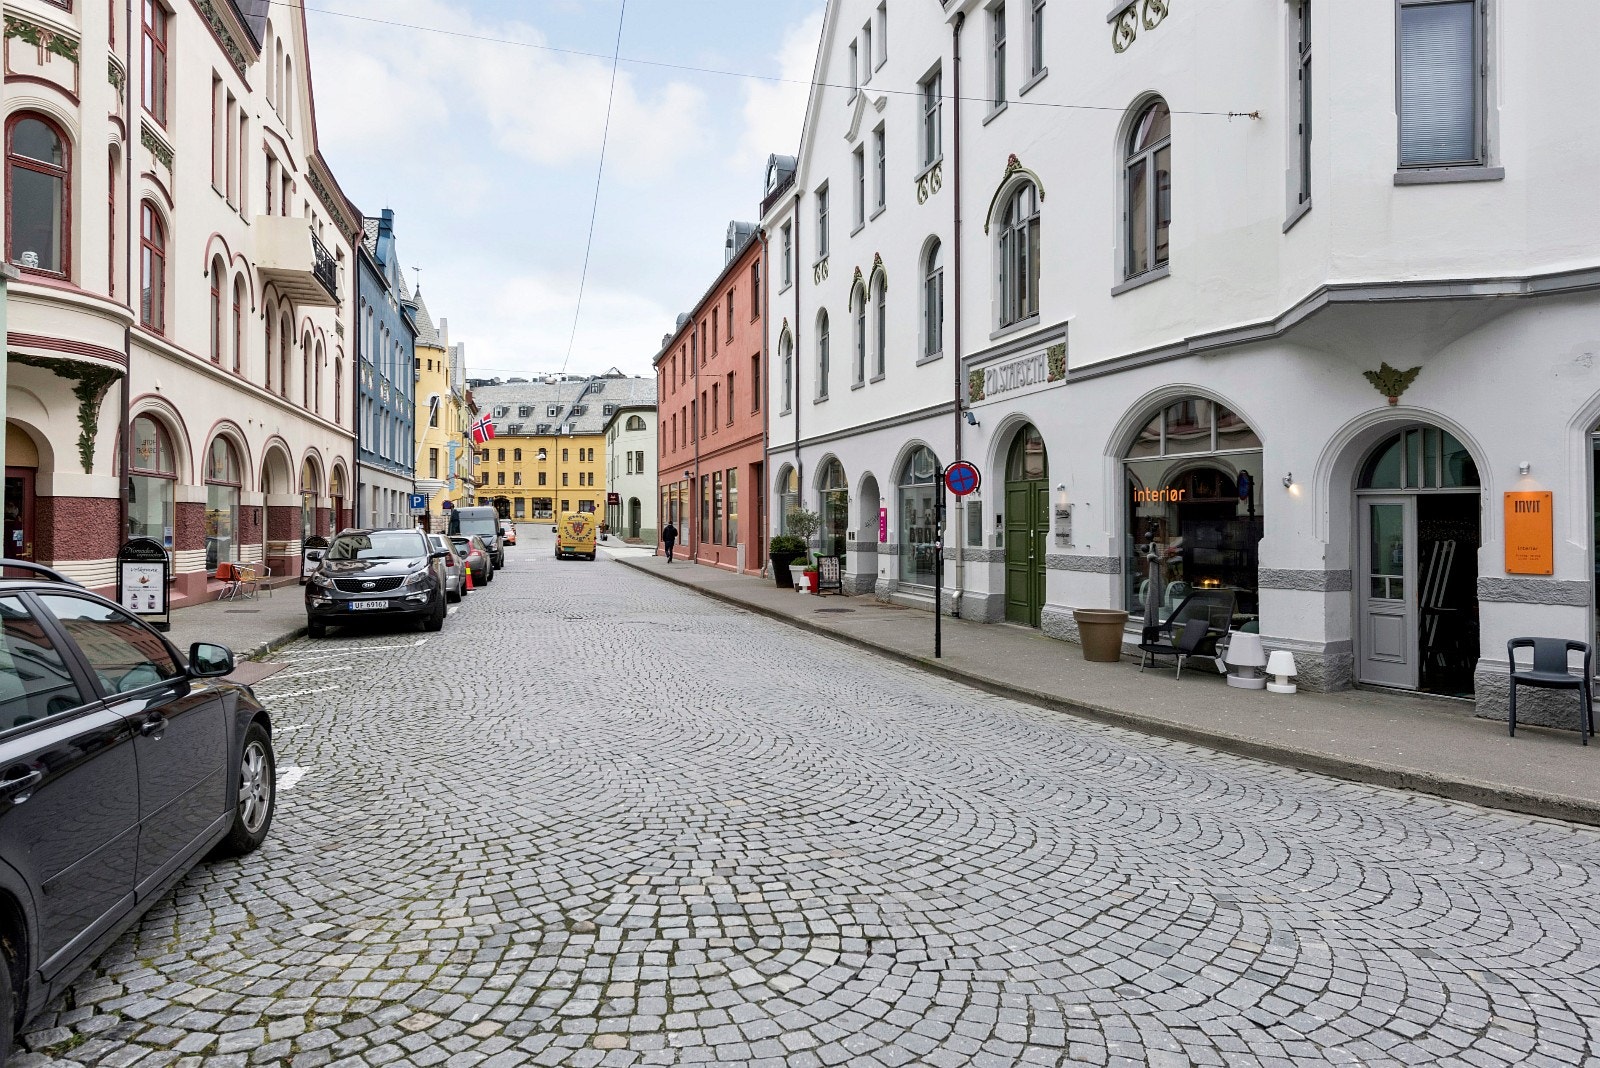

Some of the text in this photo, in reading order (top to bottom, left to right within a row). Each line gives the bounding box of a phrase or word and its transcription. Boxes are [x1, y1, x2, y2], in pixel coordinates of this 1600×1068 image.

[1133, 485, 1186, 502] interiør
[413, 496, 422, 507] P
[1514, 500, 1541, 513] INVIT
